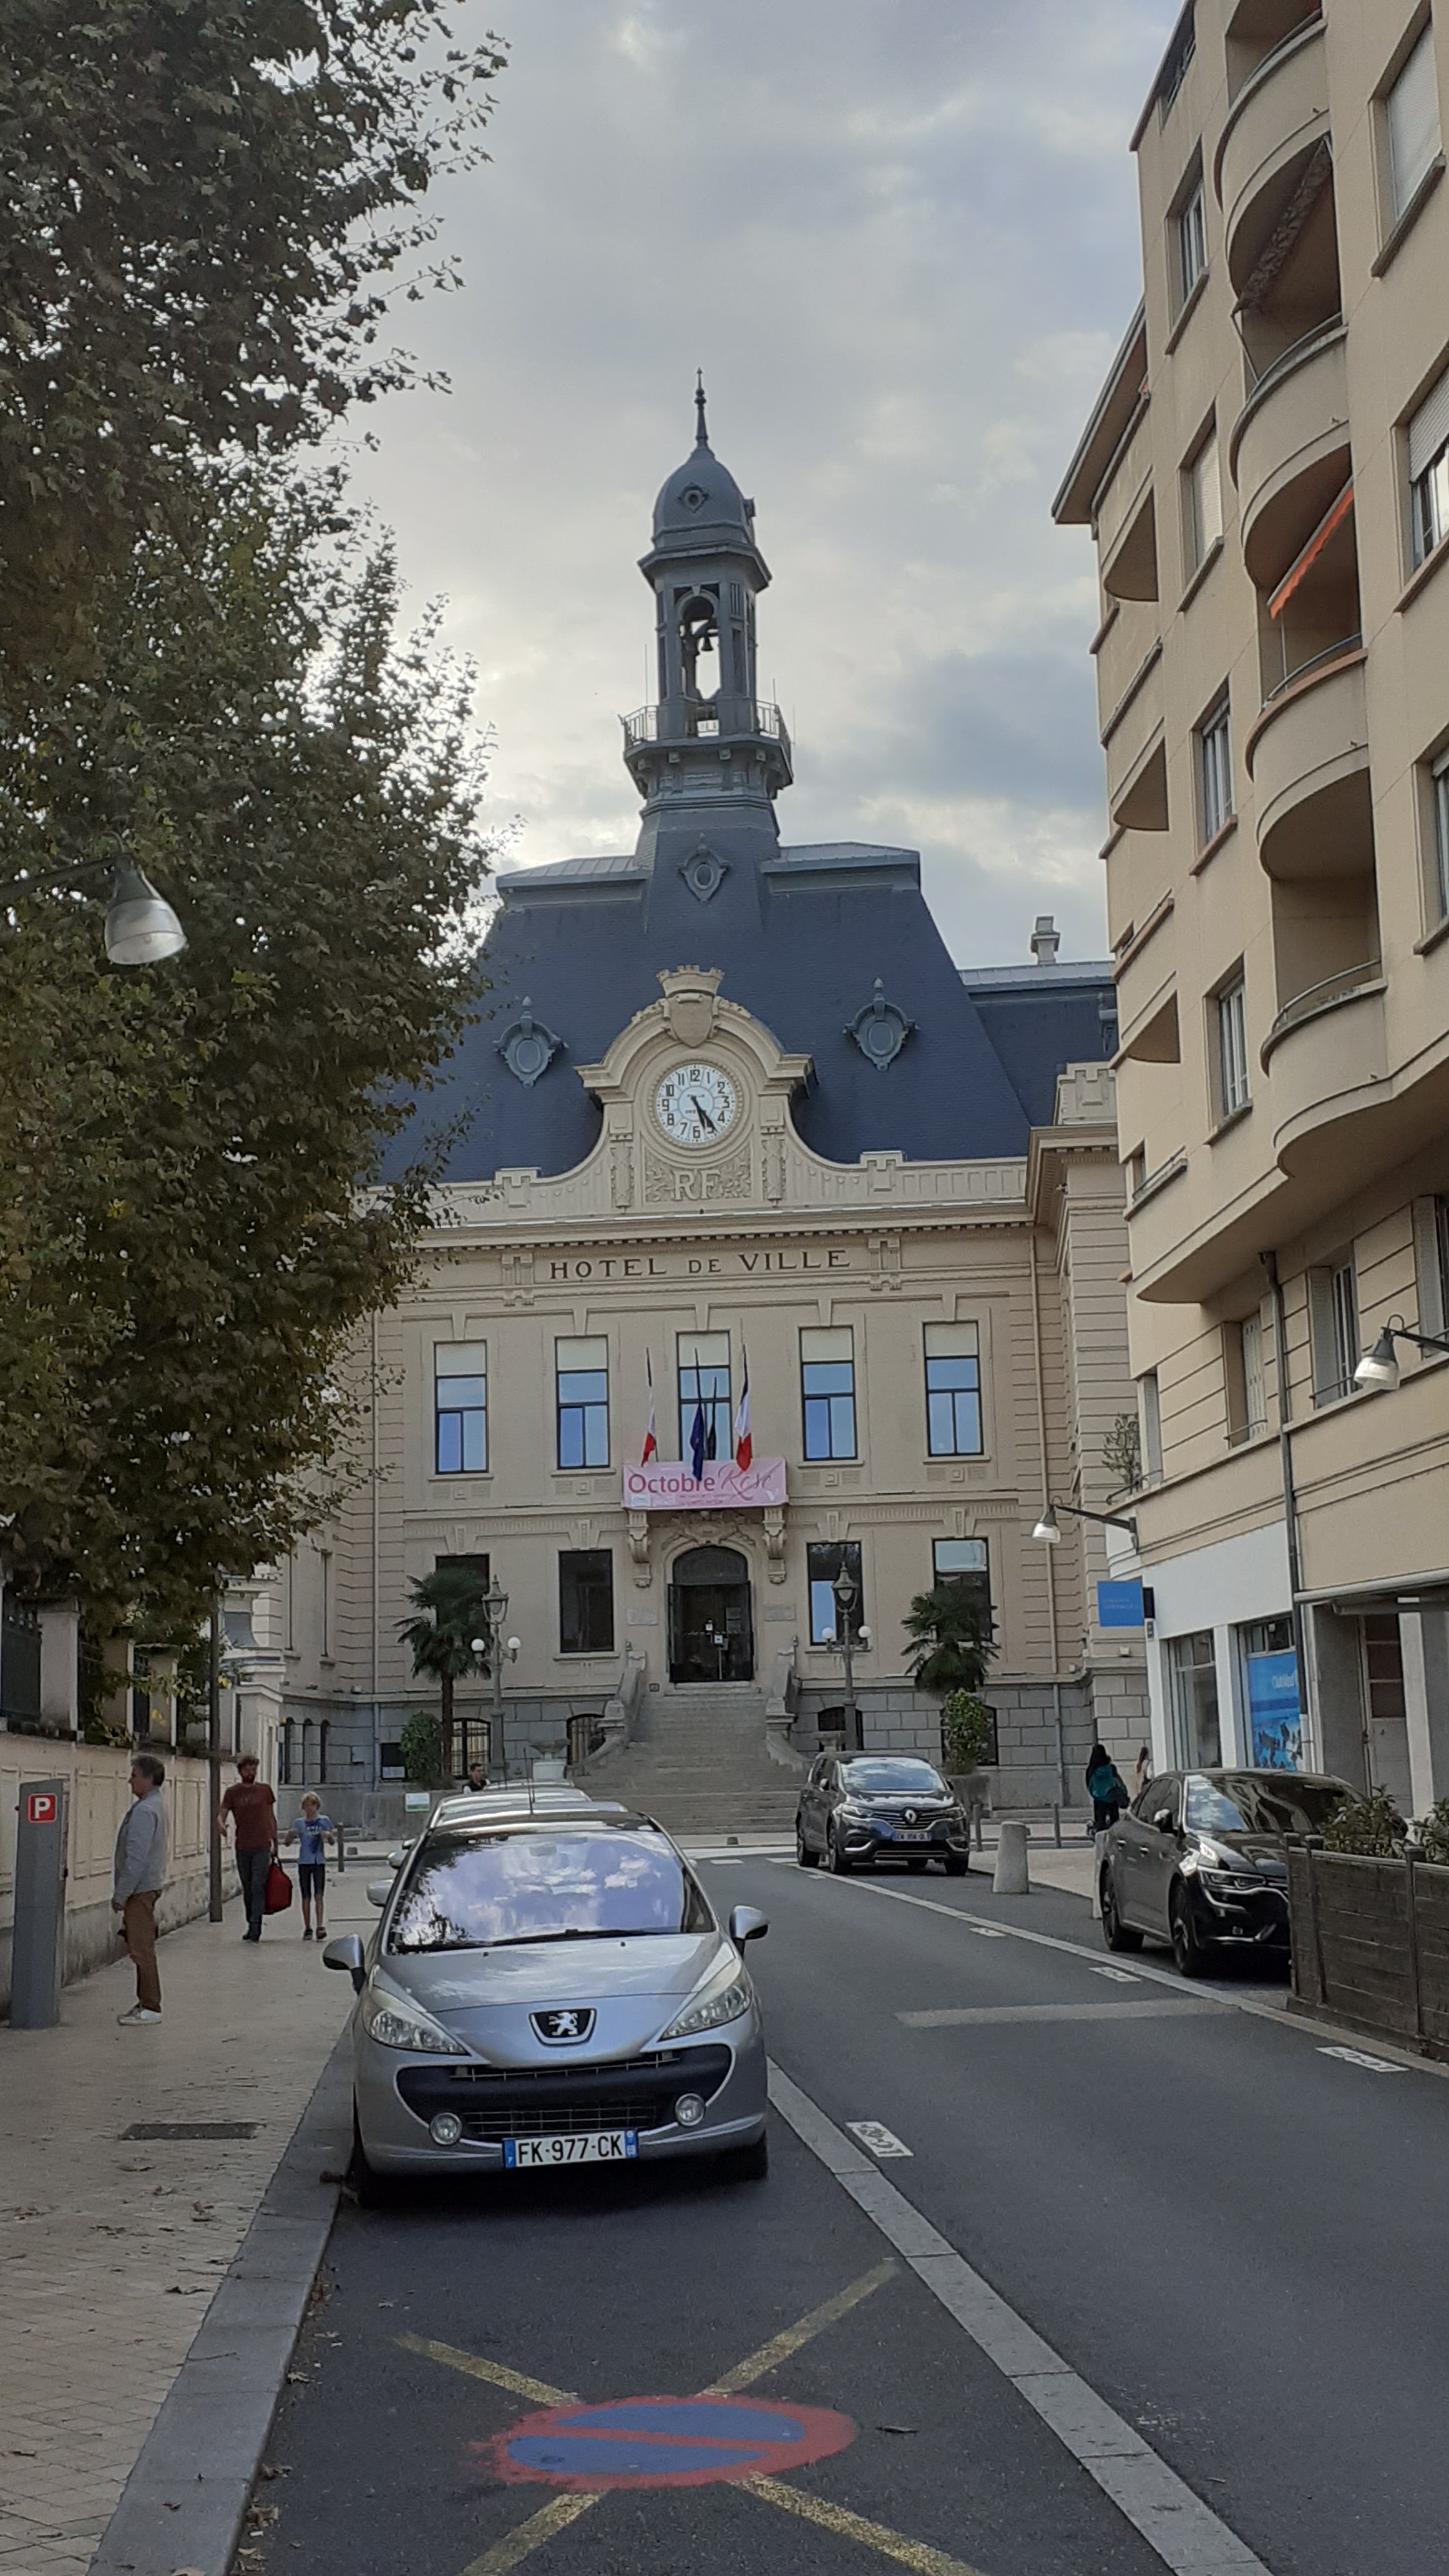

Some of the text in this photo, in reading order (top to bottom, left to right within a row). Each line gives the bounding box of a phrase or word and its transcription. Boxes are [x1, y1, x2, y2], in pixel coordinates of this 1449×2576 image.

[678, 1072, 685, 1086] 11
[690, 1069, 701, 1082] 12
[665, 1084, 675, 1097] 10
[717, 1081, 725, 1094] 2
[661, 1098, 670, 1111] 9
[721, 1096, 730, 1109] 3
[667, 1113, 675, 1126] 8
[717, 1111, 725, 1123] 4
[680, 1122, 688, 1135] 7
[692, 1125, 701, 1139] 6
[673, 1169, 721, 1201] RF
[549, 1249, 851, 1280] HOTEL DE VILLE
[628, 1473, 715, 1494] Octobre
[34, 1797, 51, 1819] P
[517, 2134, 623, 2164] FK-977-CK
